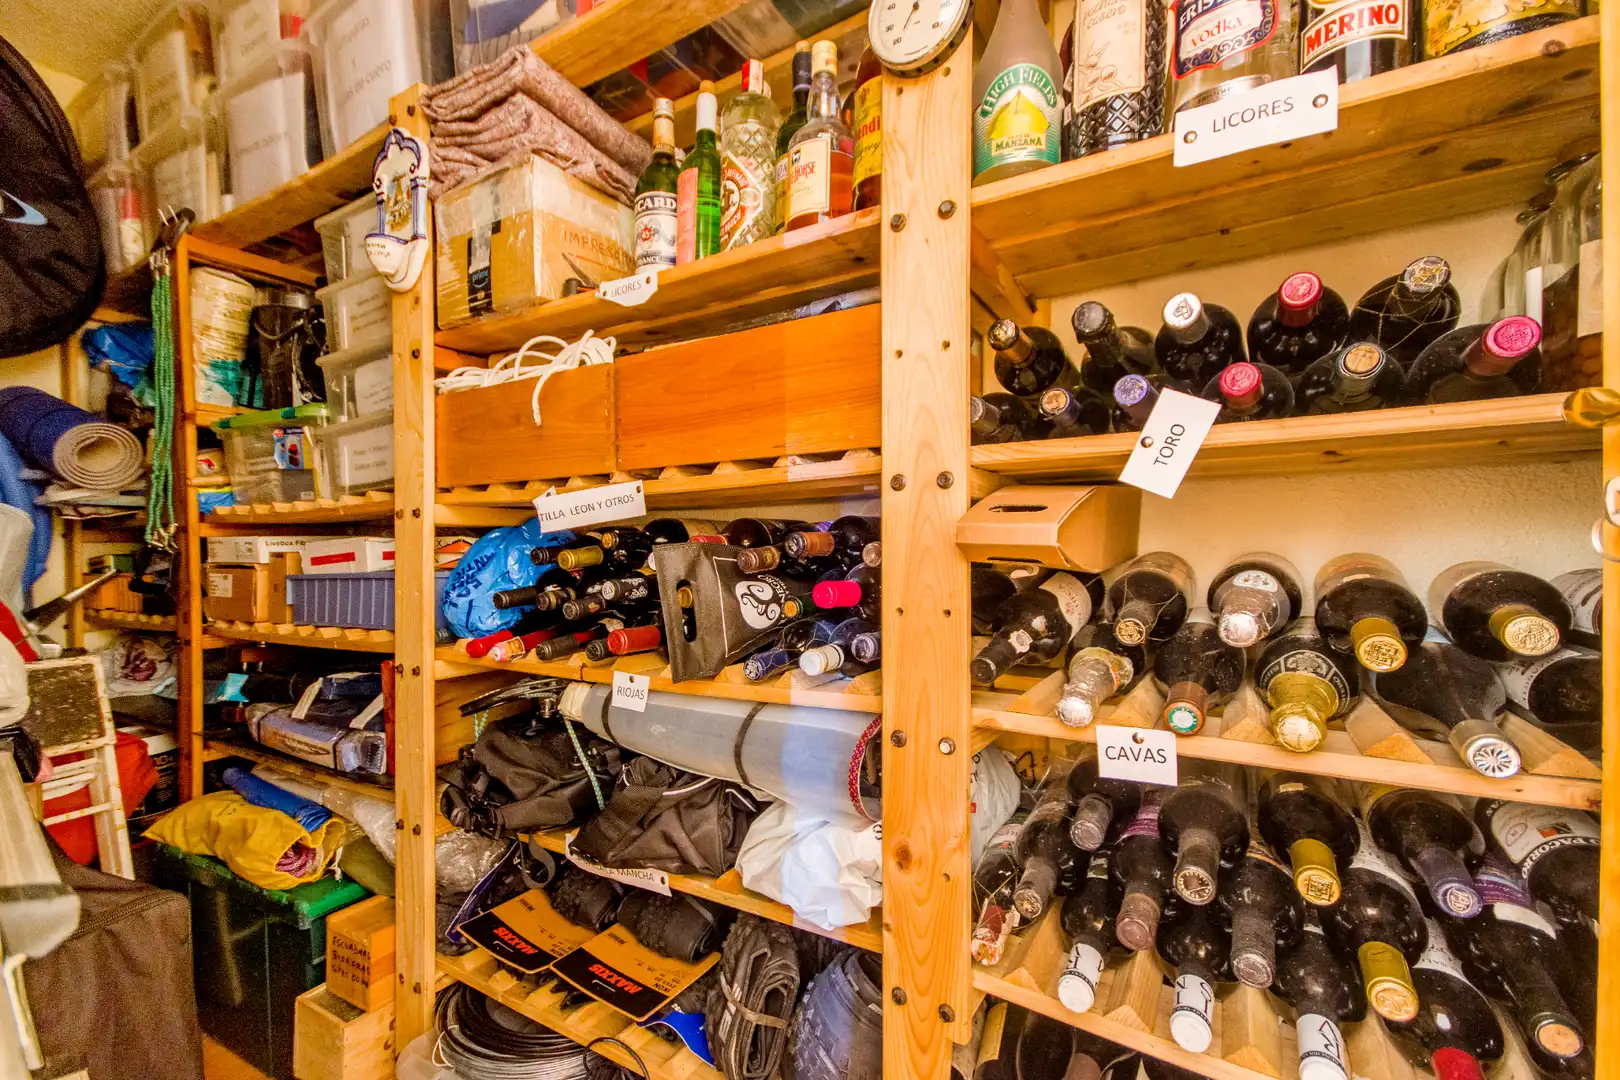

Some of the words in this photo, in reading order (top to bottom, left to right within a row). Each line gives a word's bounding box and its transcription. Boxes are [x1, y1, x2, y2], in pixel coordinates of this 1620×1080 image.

[887, 3, 896, 11] 40
[885, 24, 894, 33] 30
[1191, 17, 1244, 47] vodka
[1305, 3, 1400, 57] MERINO
[985, 71, 1015, 112] HIGH
[1019, 66, 1057, 108] FIELDS
[1212, 96, 1295, 133] LICORES
[995, 136, 1043, 152] MANZANA
[611, 279, 642, 297] LICORES
[1153, 424, 1186, 466] TORO
[539, 509, 566, 522] TILLA
[570, 502, 596, 516] LEON
[596, 501, 603, 509] Y
[605, 493, 635, 508] OTROS
[616, 685, 645, 700] RIOJAS
[1104, 745, 1167, 764] CAVAS
[617, 868, 655, 882] MANCHA
[493, 926, 539, 955] MAXXIS
[588, 963, 643, 995] MAXXIS
